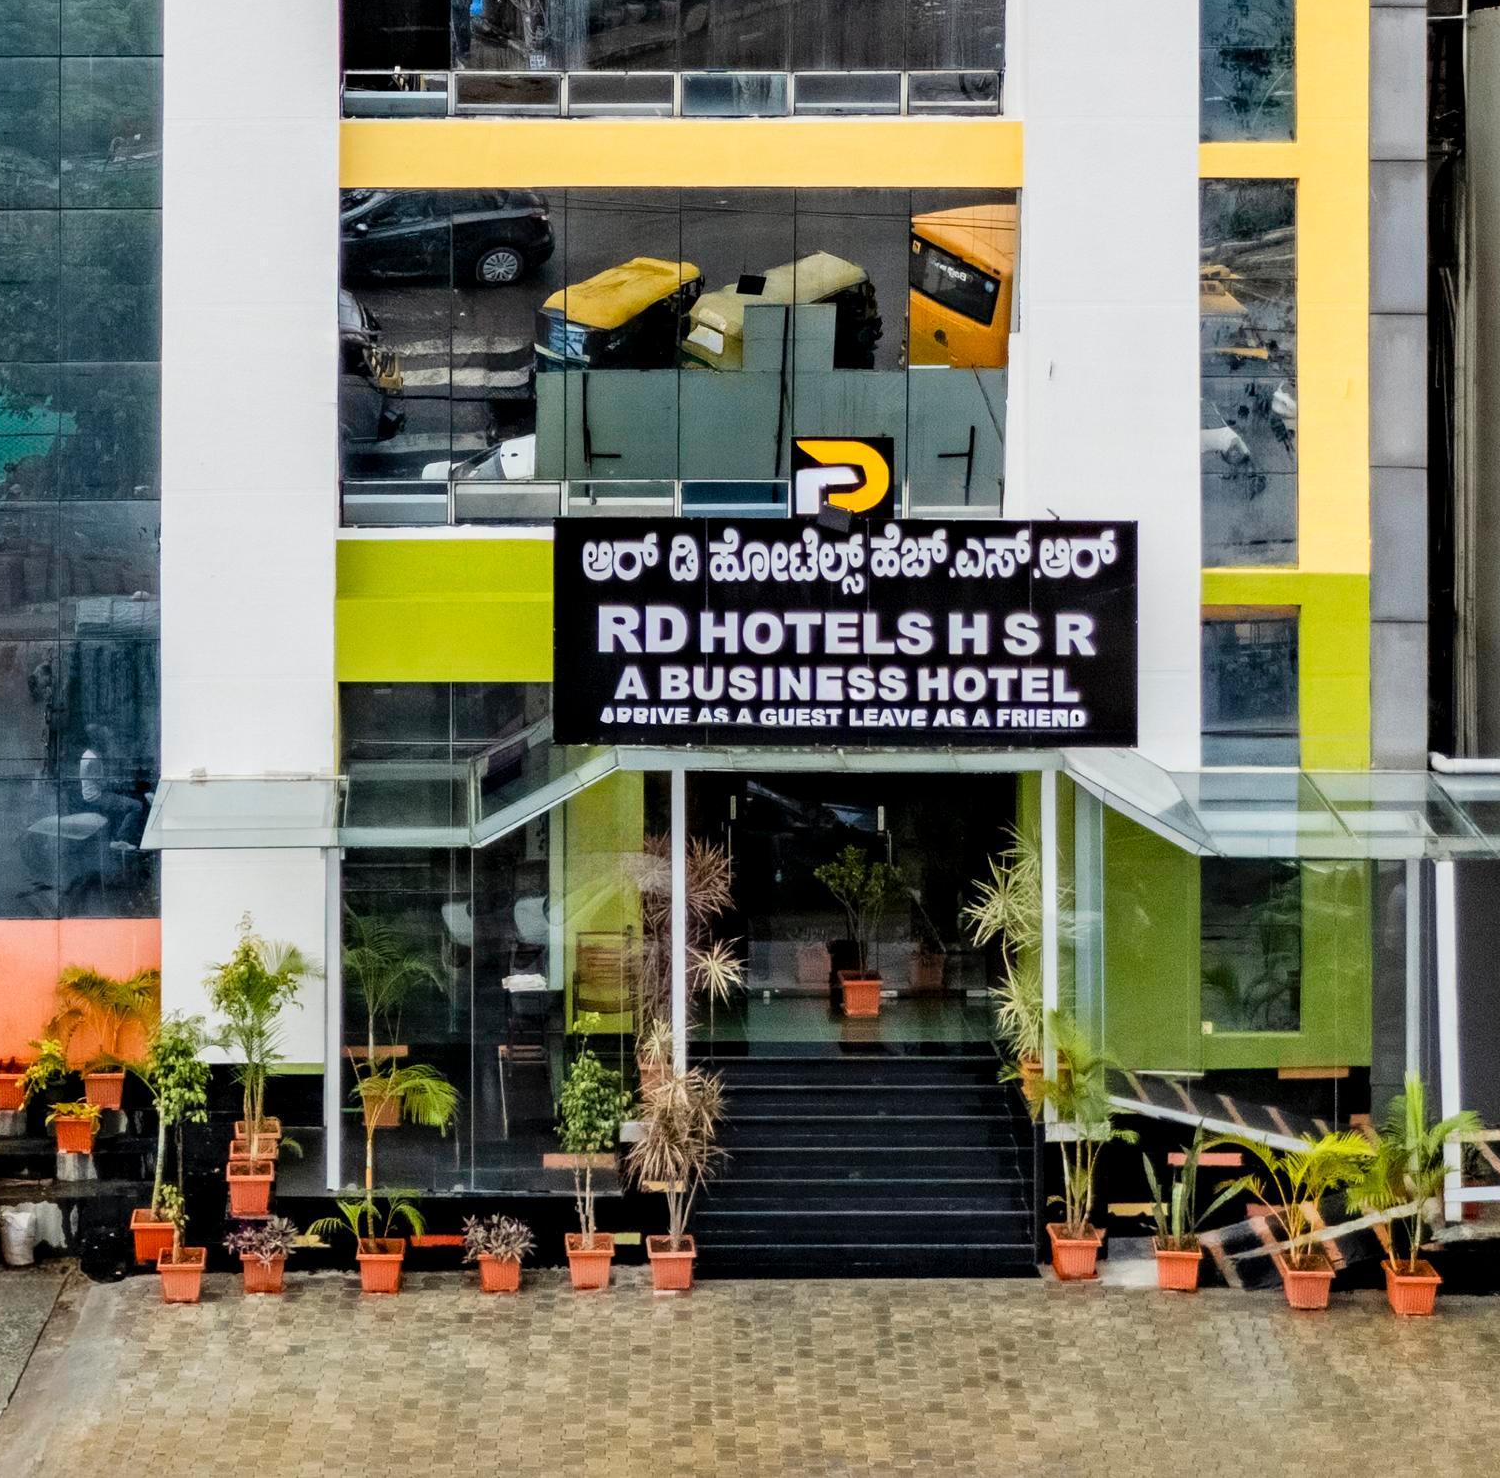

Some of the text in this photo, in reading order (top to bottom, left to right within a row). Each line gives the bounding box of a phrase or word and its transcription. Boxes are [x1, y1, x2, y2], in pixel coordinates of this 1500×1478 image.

[669, 535, 699, 581] ಡಿ
[598, 605, 688, 653] RD
[700, 611, 933, 656] HOTELS
[614, 666, 1080, 702] A BUSINESS HOTEL
[697, 707, 729, 724] AS
[736, 707, 753, 724] A
[760, 708, 842, 726] GUEST
[849, 709, 927, 727] LEAVE
[932, 709, 967, 727] AS
[972, 709, 990, 727] A
[996, 709, 1086, 728] FRIEND
